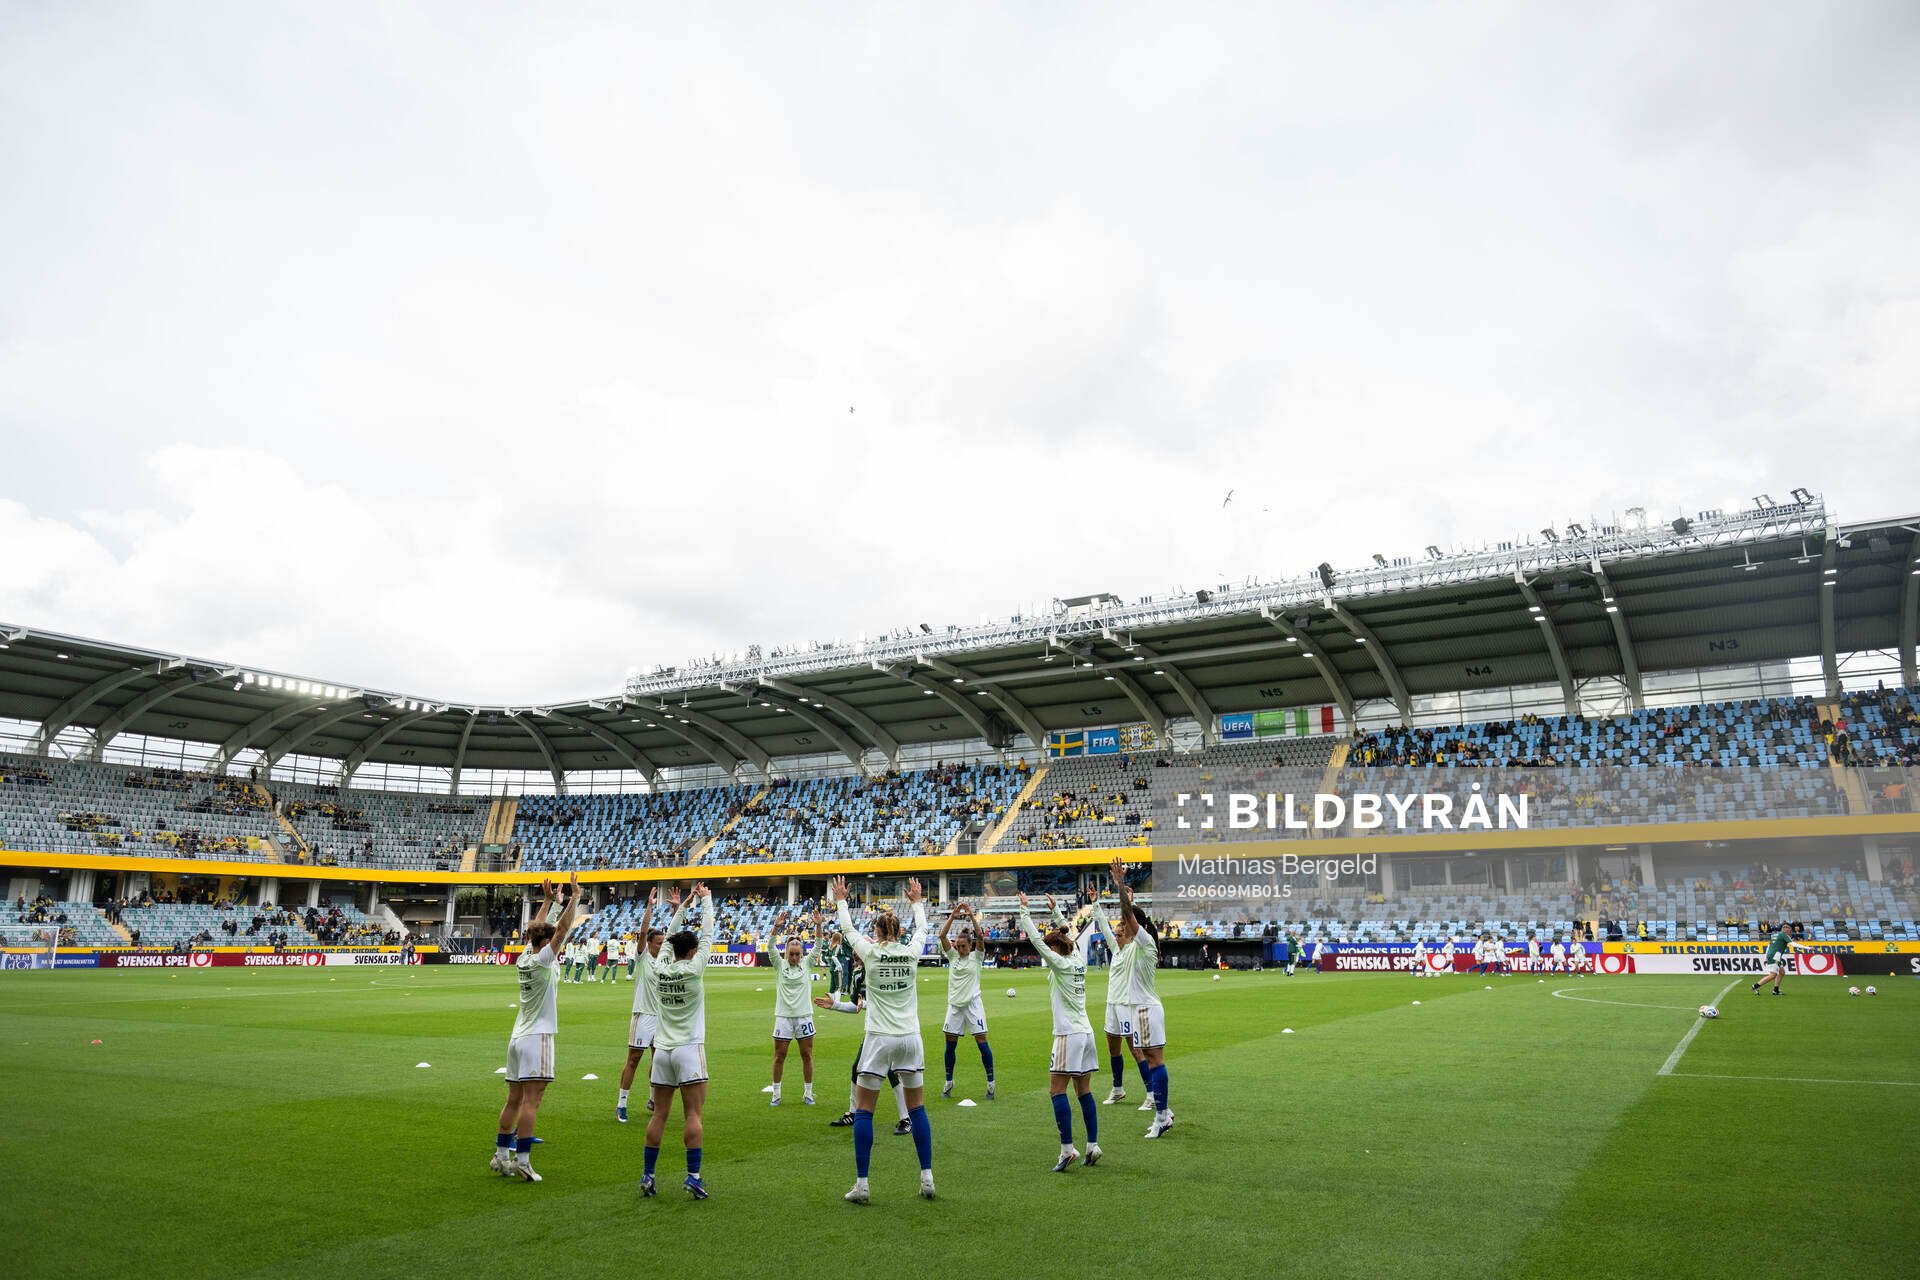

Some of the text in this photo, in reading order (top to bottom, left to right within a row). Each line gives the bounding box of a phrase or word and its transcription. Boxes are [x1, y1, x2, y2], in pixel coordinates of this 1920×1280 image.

[1709, 639, 1740, 651] N3
[1466, 666, 1493, 678] N4
[1260, 687, 1283, 698] N5
[1081, 706, 1102, 716] L5
[1223, 721, 1252, 732] UEFA
[1092, 736, 1116, 748] FIFA
[117, 955, 189, 967] SVENSKA SPEL
[244, 955, 303, 966] SVENSKA SPE
[354, 955, 388, 965] SVENSKA
[449, 954, 496, 964] SVENSKA SPE
[725, 954, 738, 965] SPE
[880, 954, 909, 963] Poste
[1336, 956, 1391, 970] SVENSKA
[1692, 957, 1763, 972] SVENSKA
[1911, 957, 1920, 973] S
[890, 968, 910, 977] TIM
[669, 984, 686, 993] TIM
[880, 982, 896, 991] eni
[801, 1022, 815, 1036] 20
[976, 1019, 984, 1031] 4
[1120, 1021, 1131, 1034] 19
